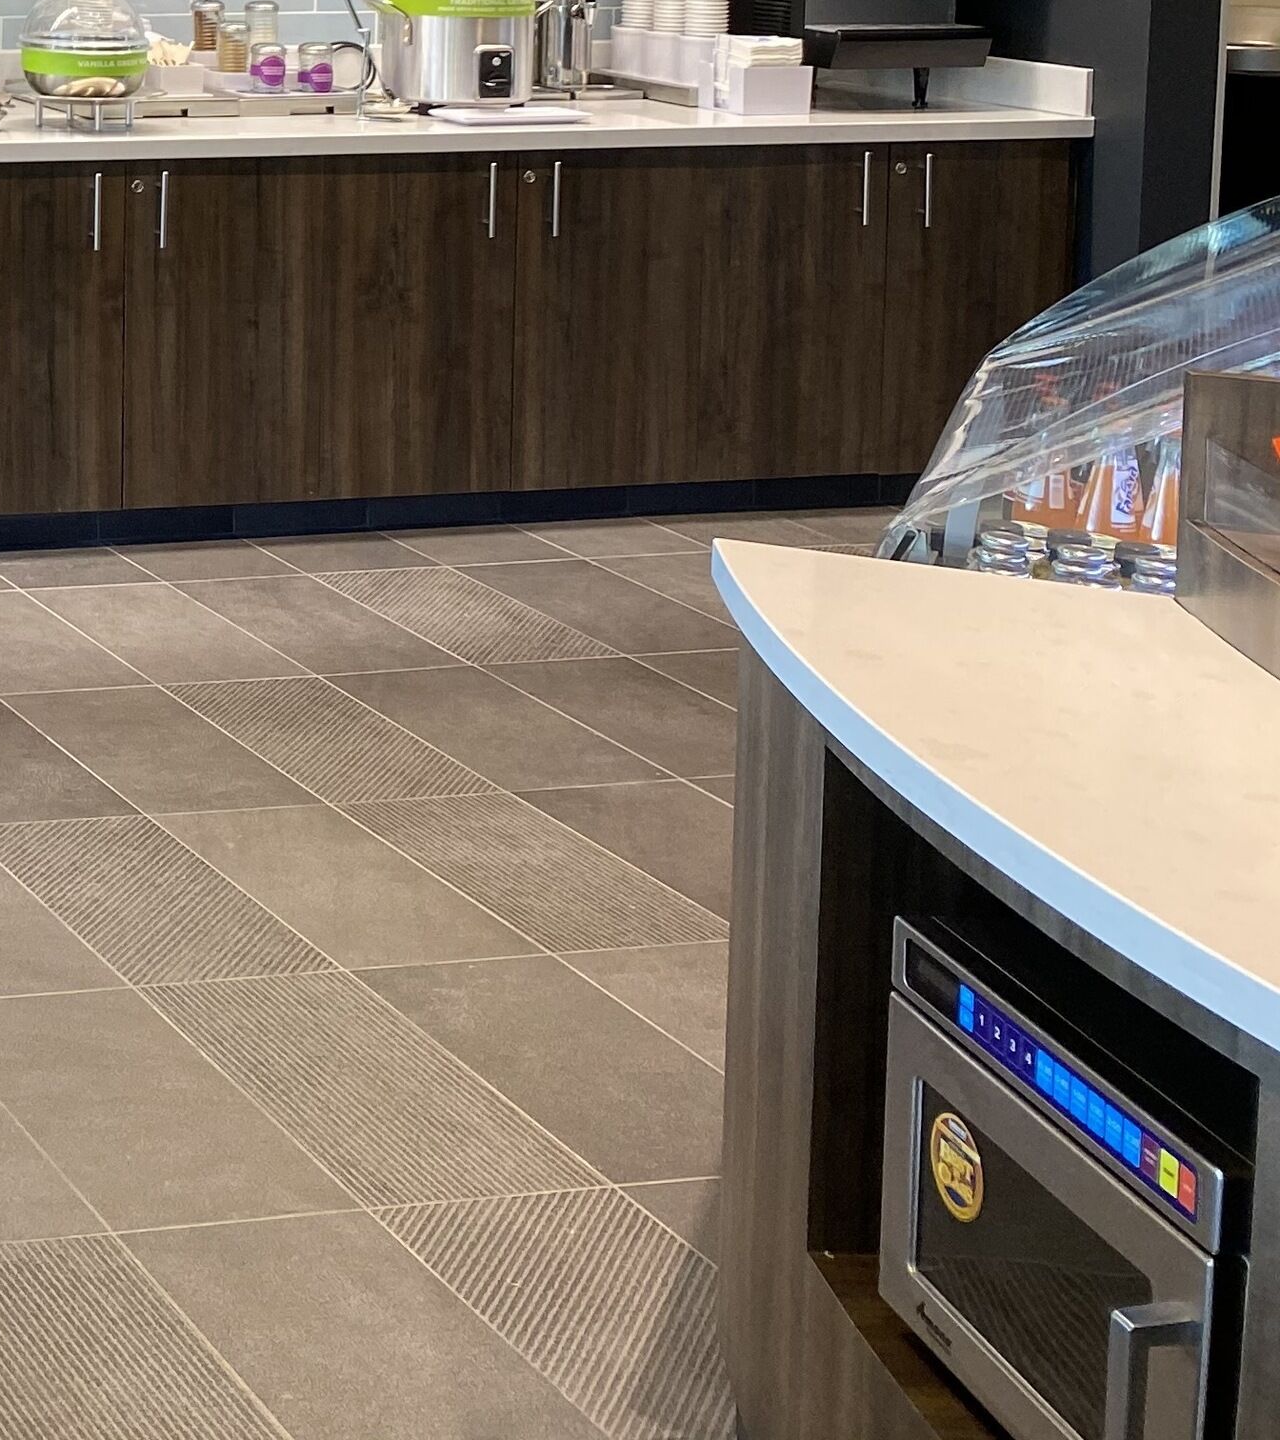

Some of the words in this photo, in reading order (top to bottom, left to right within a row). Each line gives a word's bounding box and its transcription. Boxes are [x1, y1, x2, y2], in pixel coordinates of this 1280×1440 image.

[78, 60, 115, 68] VANILLA
[979, 1014, 985, 1027] 1
[994, 1025, 1001, 1040] 2
[1009, 1038, 1016, 1052] 3
[1024, 1052, 1032, 1065] 4
